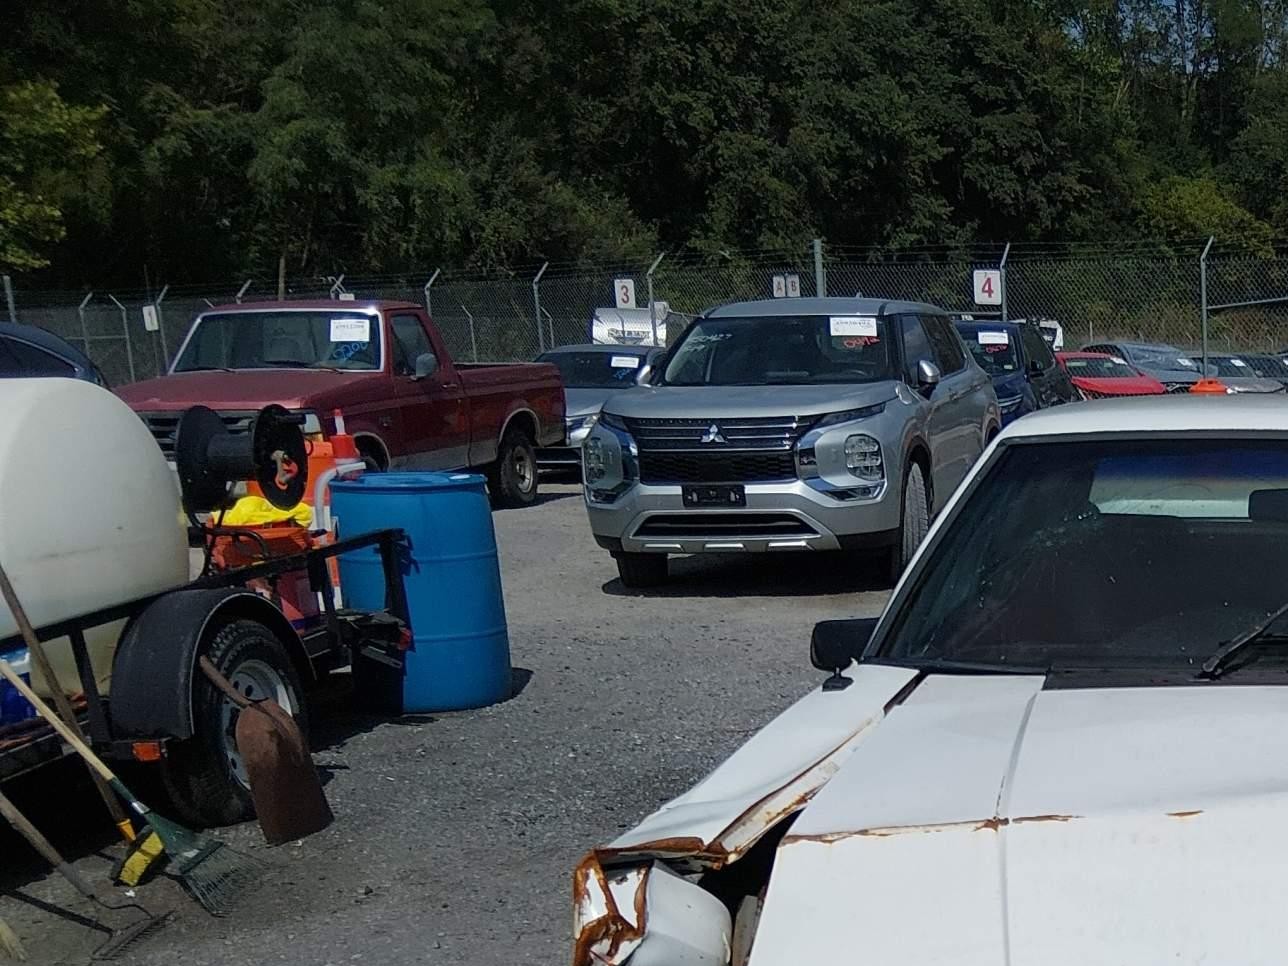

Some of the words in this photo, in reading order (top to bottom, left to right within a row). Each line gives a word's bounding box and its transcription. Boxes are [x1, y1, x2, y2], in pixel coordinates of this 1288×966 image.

[620, 284, 630, 304] 3
[775, 280, 783, 292] A
[790, 280, 798, 292] B
[981, 277, 995, 299] 4
